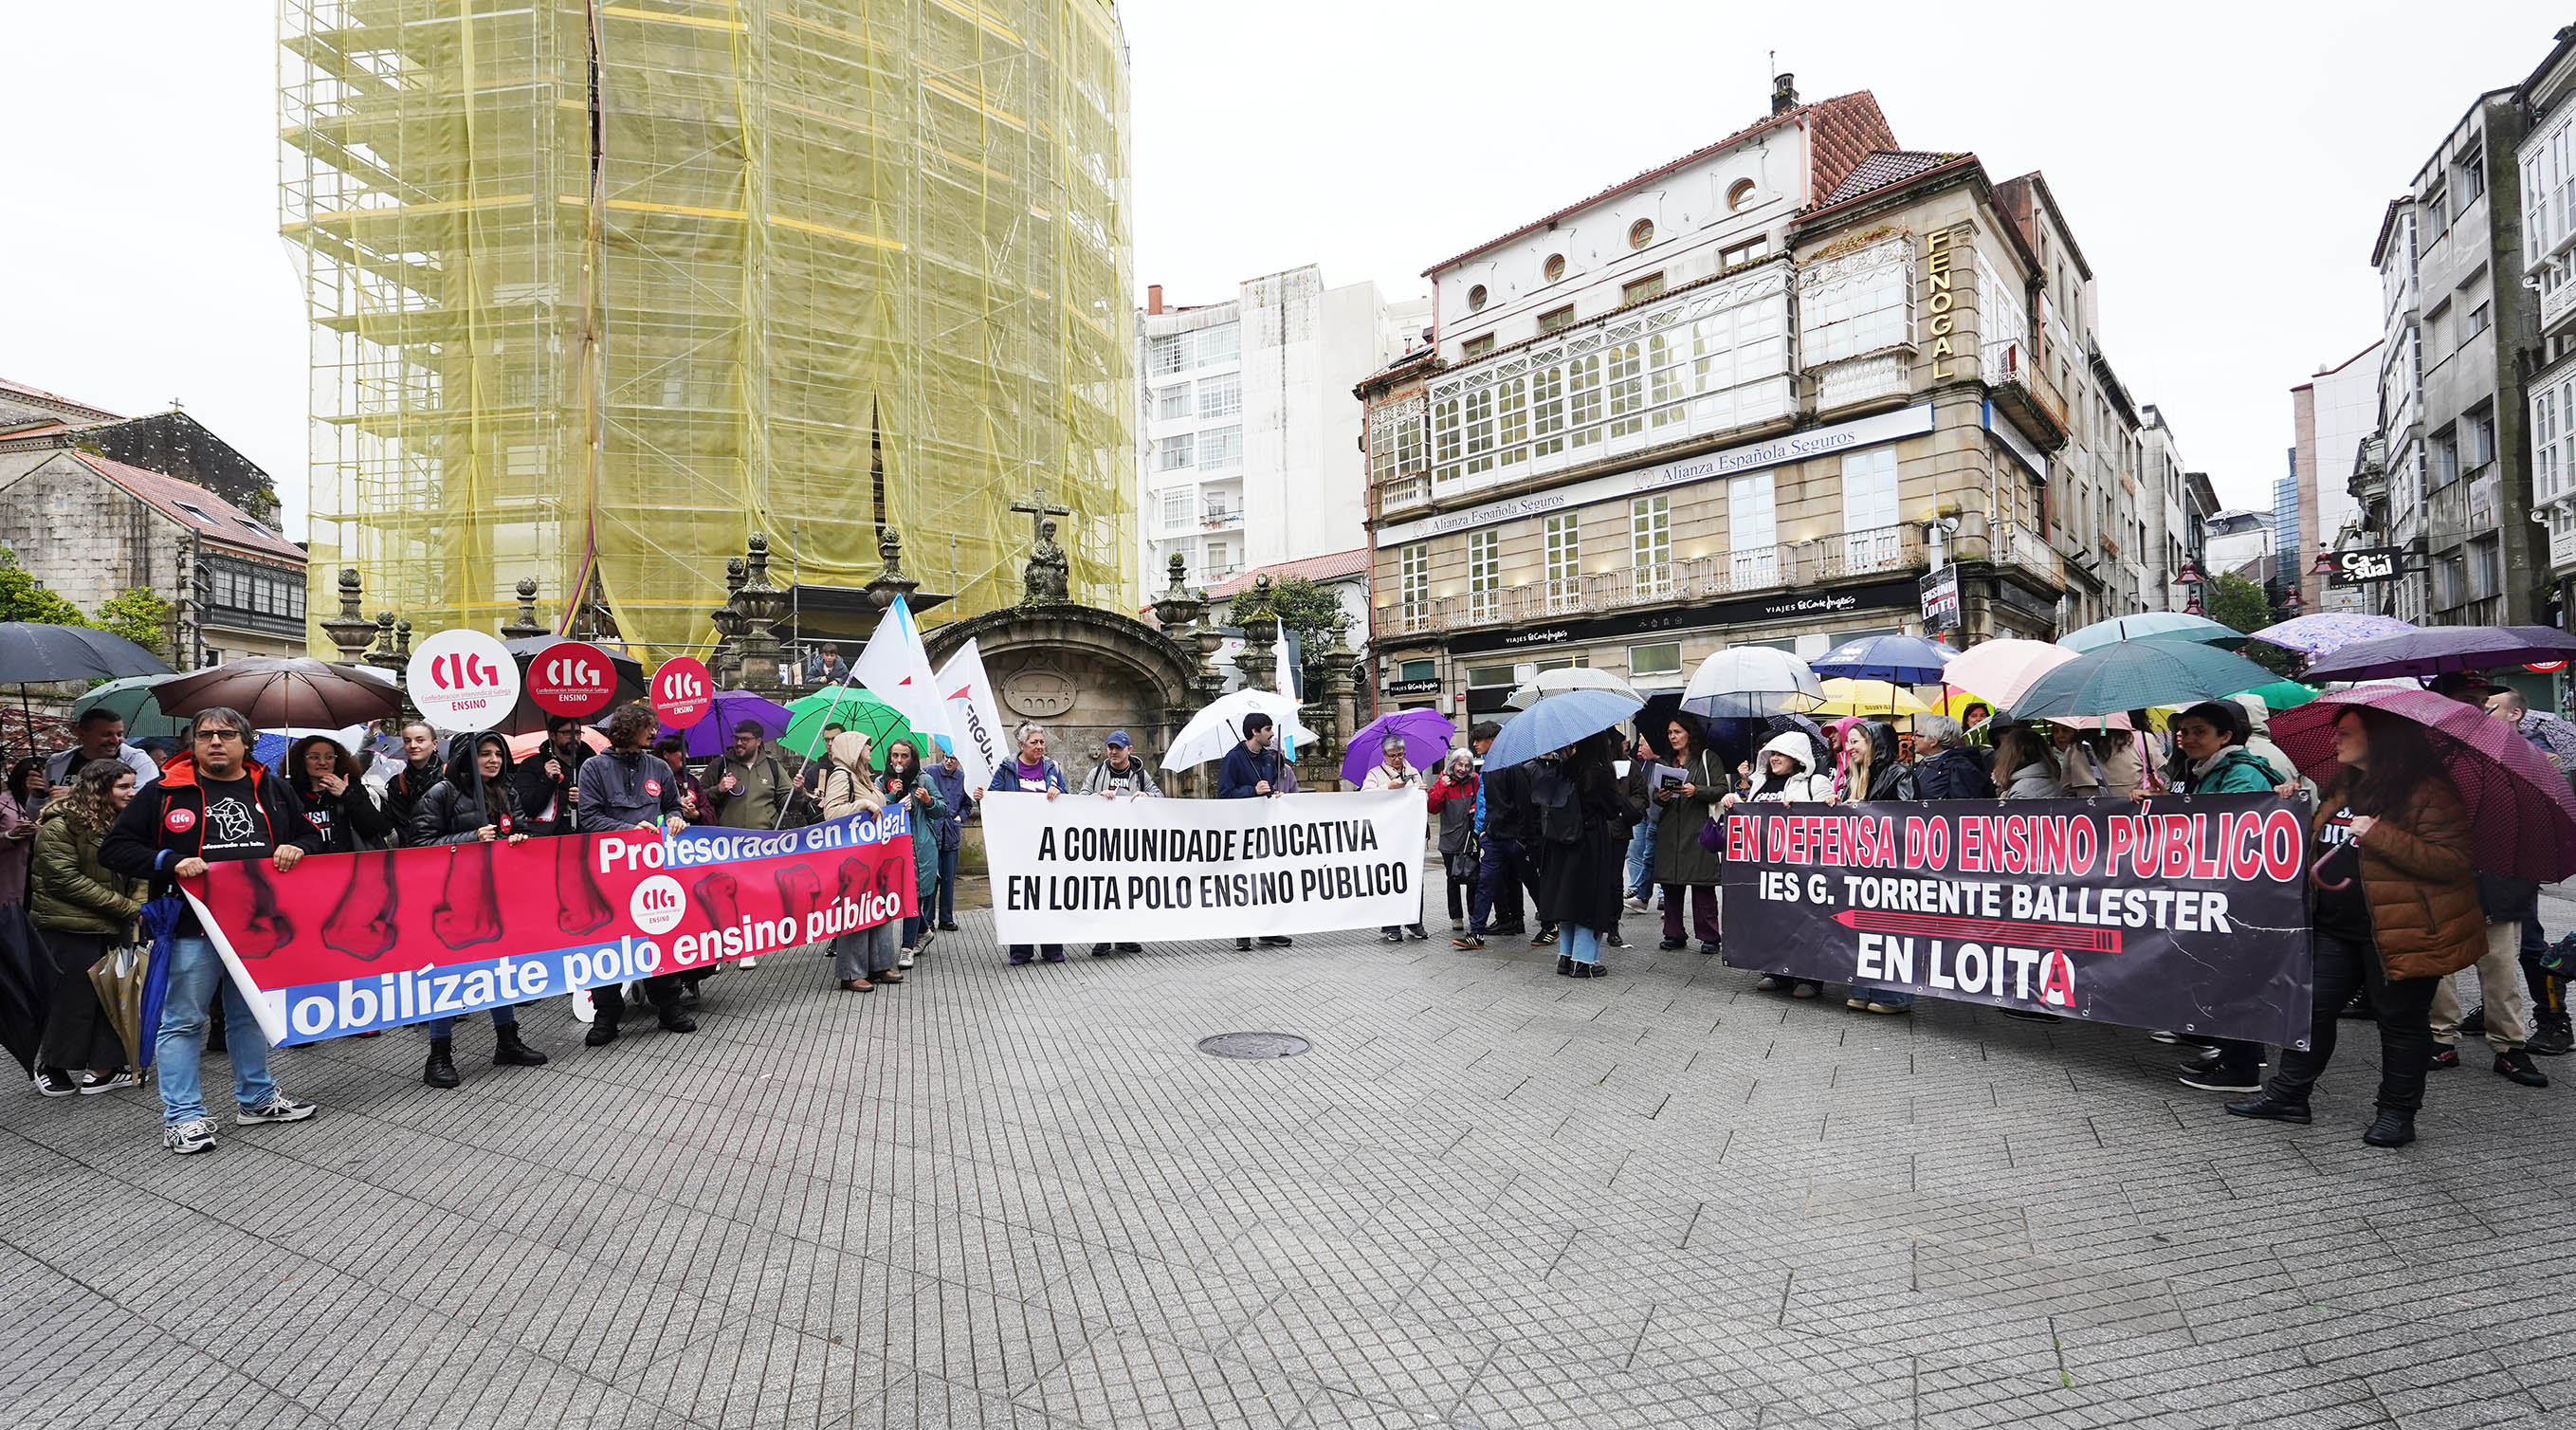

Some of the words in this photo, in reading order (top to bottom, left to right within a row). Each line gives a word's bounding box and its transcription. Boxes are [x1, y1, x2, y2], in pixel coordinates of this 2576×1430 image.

[1927, 229, 1954, 379] FENOGAL
[1661, 463, 1713, 483] Alianza
[1719, 447, 1785, 471] Española
[1792, 431, 1855, 454] Seguros
[1432, 517, 1469, 532] Alianza
[1471, 504, 1517, 523] Española
[1521, 494, 1564, 512] Seguros
[2354, 558, 2393, 579] sual
[1765, 604, 1796, 614] VIAJES
[1798, 600, 1806, 610] El
[1806, 599, 1826, 609] Corte
[1826, 596, 1855, 610] Inglés
[1922, 580, 1955, 604] ENSINO
[431, 652, 499, 689] CIG
[546, 658, 600, 686] CIG
[664, 671, 701, 700] CIG
[451, 699, 486, 711] ENSINO
[558, 693, 587, 702] ENSINO
[673, 705, 694, 715] ENSINO
[599, 833, 797, 873] Profesorado
[805, 823, 841, 851] en
[849, 807, 905, 845] folga!
[1038, 827, 1056, 861] A
[1064, 827, 1236, 862] COMUNIDADE
[1242, 818, 1378, 860] EDUCATIVA
[1726, 816, 1761, 863] EN
[1767, 816, 1897, 869] DEFENSA
[1904, 816, 1951, 871] DO
[1959, 815, 2097, 875] ENSINO
[2106, 799, 2304, 882] PÚBLICO
[643, 889, 675, 910] CIG
[1008, 875, 1041, 910] EN
[1050, 875, 1121, 910] LOITA
[1128, 875, 1192, 909] POLO
[1199, 871, 1293, 908] ENSINO
[1301, 862, 1408, 902] PÚBLICO
[1760, 871, 1800, 902] IES
[1808, 873, 1835, 905] G.
[1844, 875, 2001, 918] TORRENTE
[2012, 884, 2233, 934] BALLESTER
[649, 915, 670, 925] ENSINO
[563, 935, 662, 994] polo
[673, 914, 798, 965] ensino
[807, 891, 901, 944] público
[1856, 932, 1914, 984] EN
[1929, 940, 2076, 1008] LOITA
